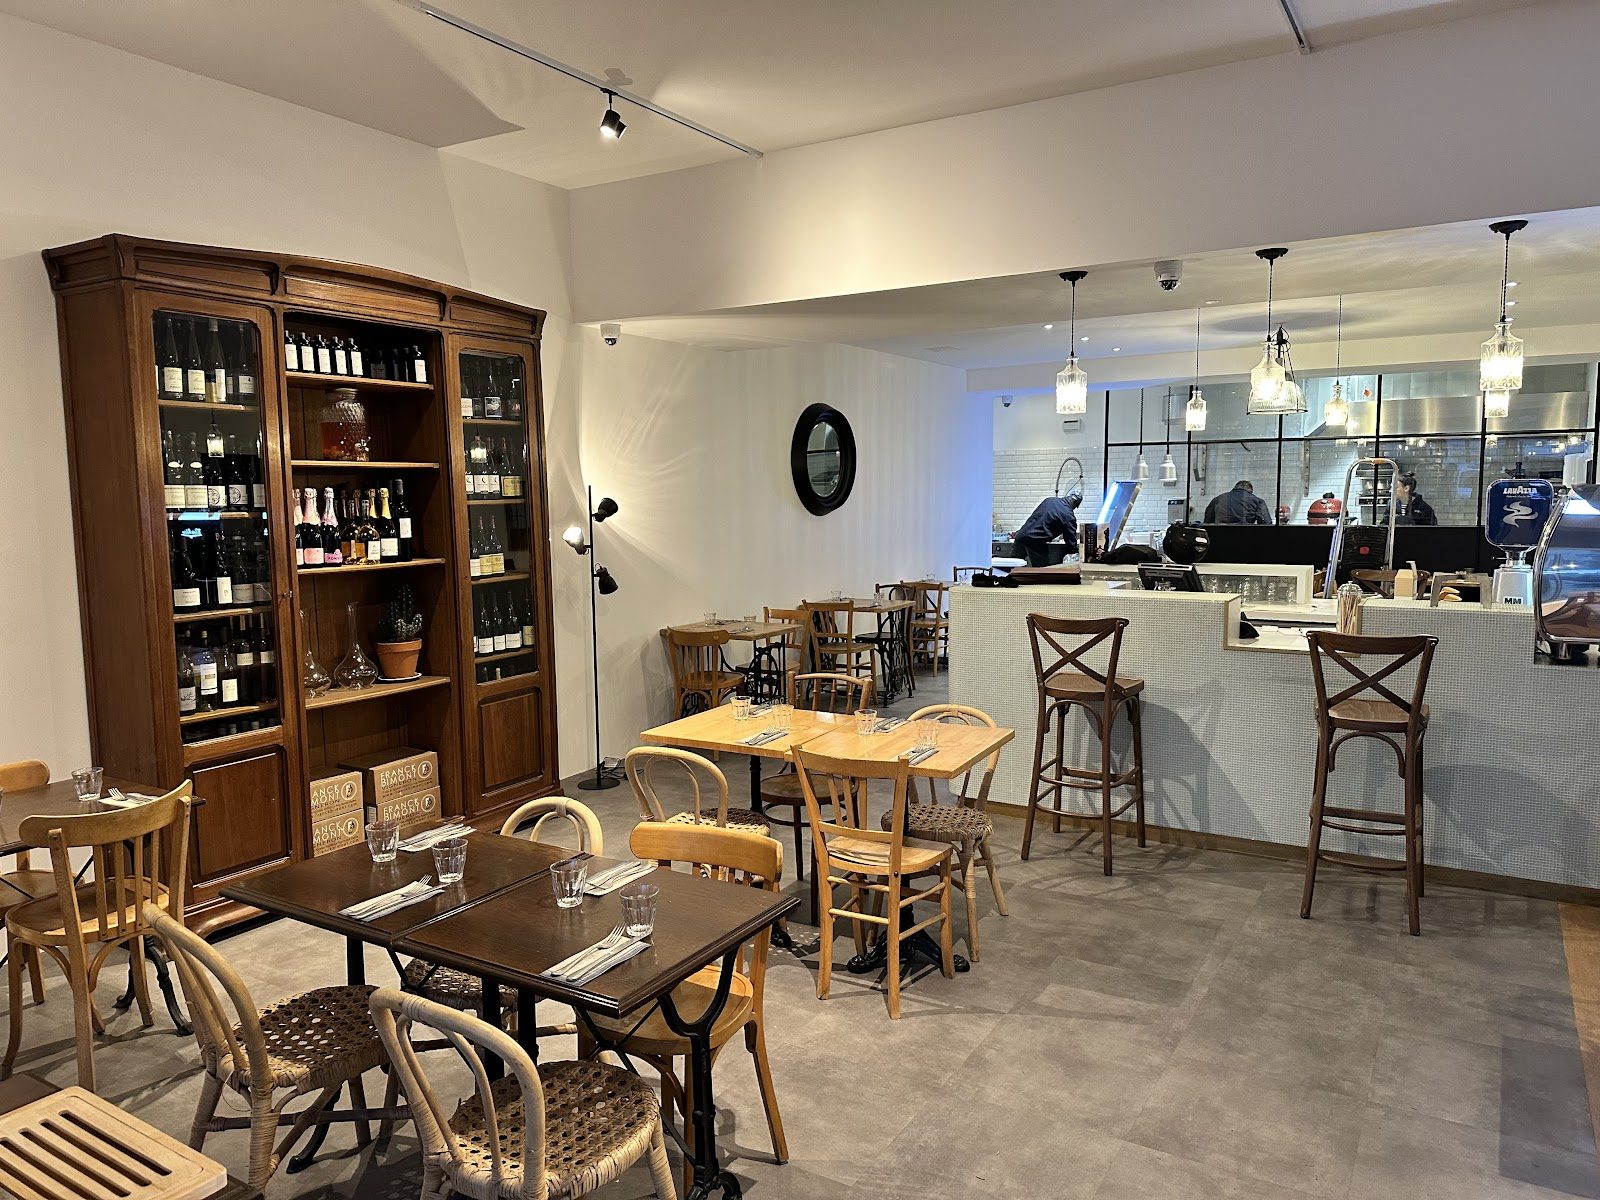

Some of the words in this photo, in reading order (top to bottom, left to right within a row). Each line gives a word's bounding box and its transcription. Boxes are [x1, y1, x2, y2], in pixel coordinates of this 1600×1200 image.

[1502, 485, 1538, 495] LAVAZZA
[380, 763, 416, 780] FRANCK
[311, 791, 340, 806] MONT
[312, 784, 340, 799] ANCK
[384, 797, 419, 814] FRANCK
[313, 829, 341, 844] MONT
[314, 821, 343, 837] ANCK
